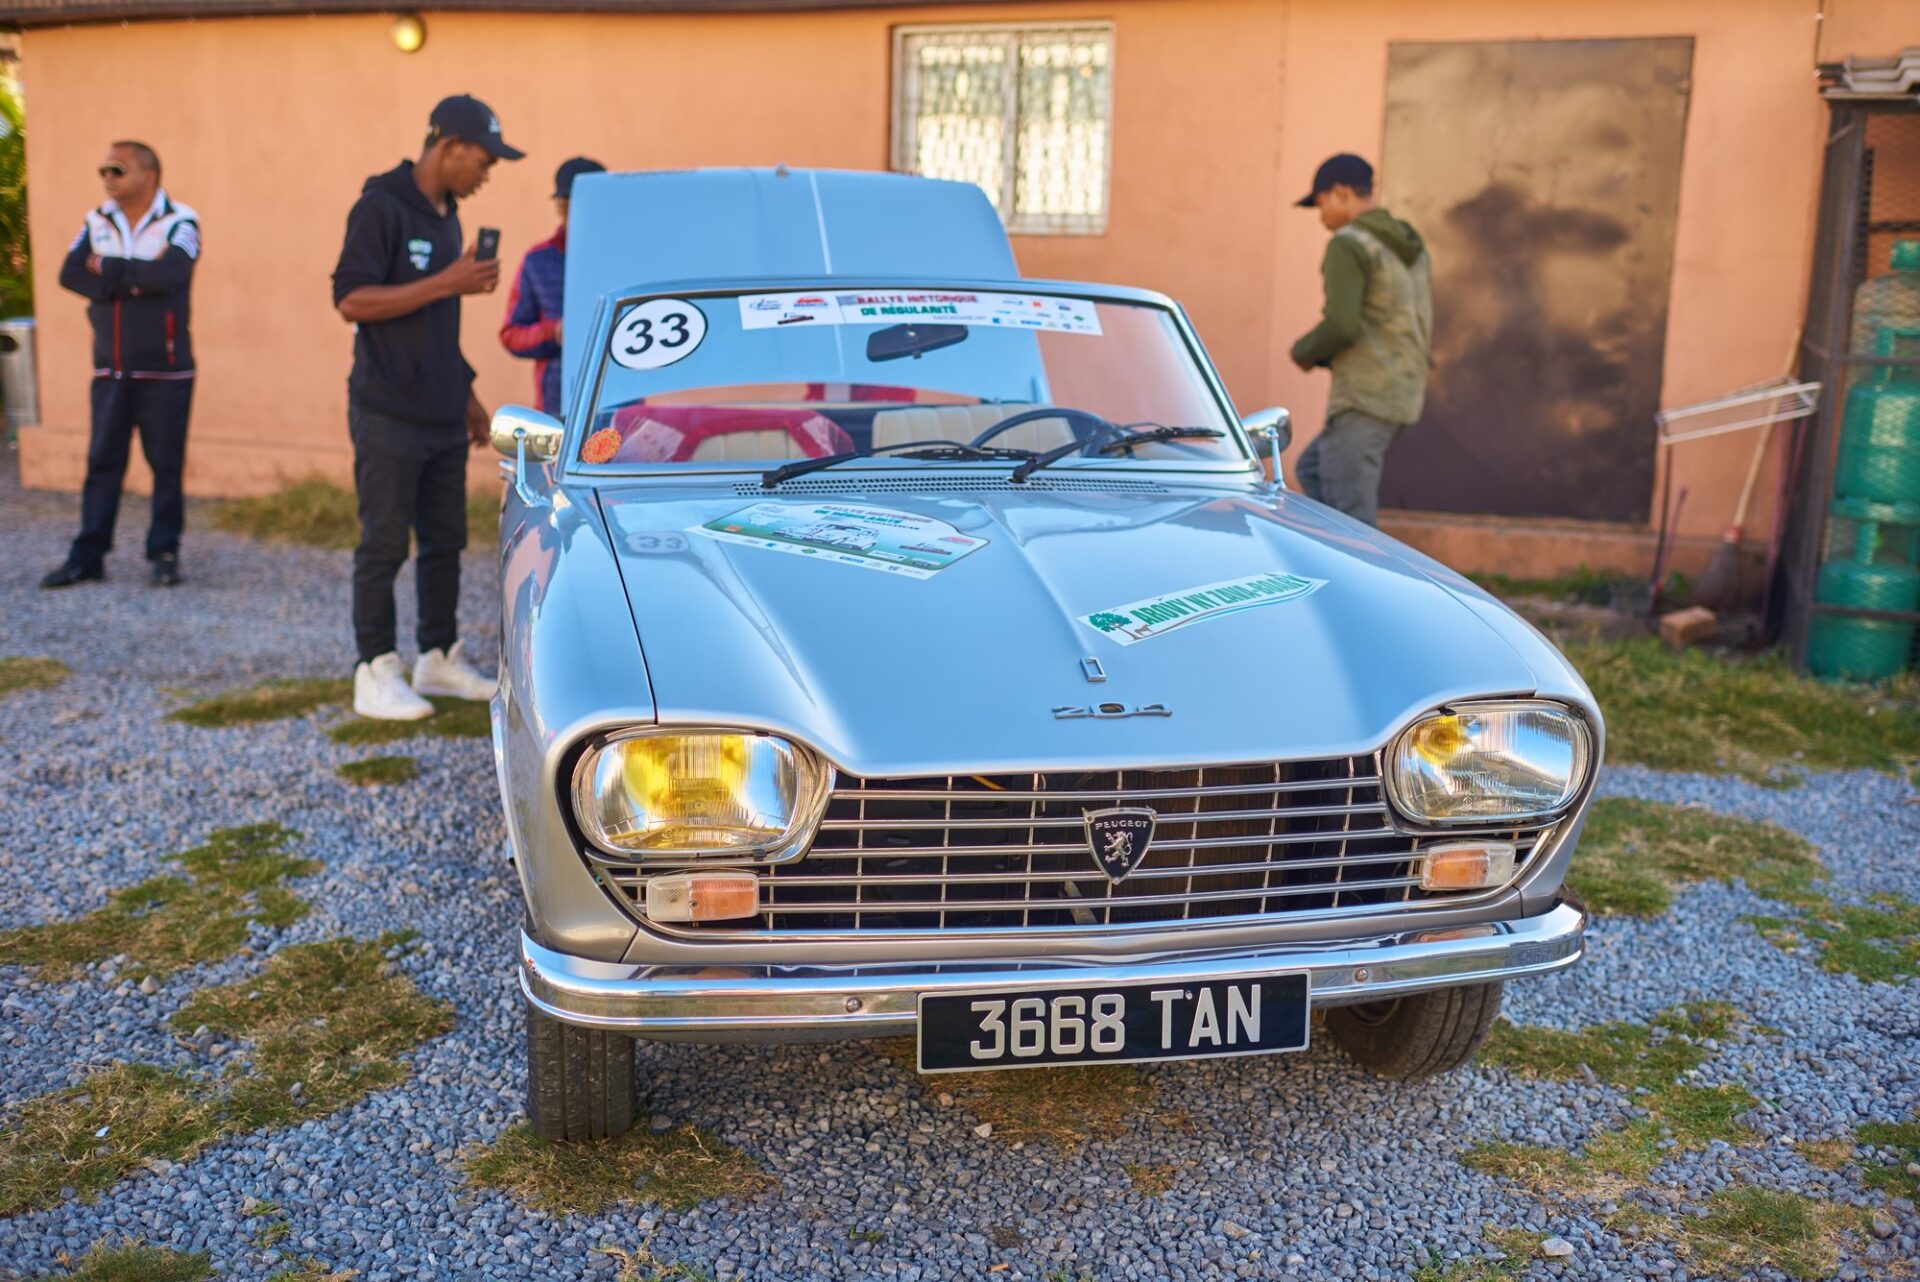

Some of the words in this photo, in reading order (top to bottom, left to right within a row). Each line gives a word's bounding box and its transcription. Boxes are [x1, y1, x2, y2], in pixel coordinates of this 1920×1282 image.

[857, 295, 903, 304] RALLYE
[860, 306, 878, 316] DE
[624, 312, 690, 356] 33
[1129, 598, 1199, 625] AROVY
[1184, 592, 1222, 610] NY
[1095, 820, 1148, 830] PEUGEOT
[970, 993, 1126, 1060] 3668
[1150, 984, 1262, 1050] TAN
